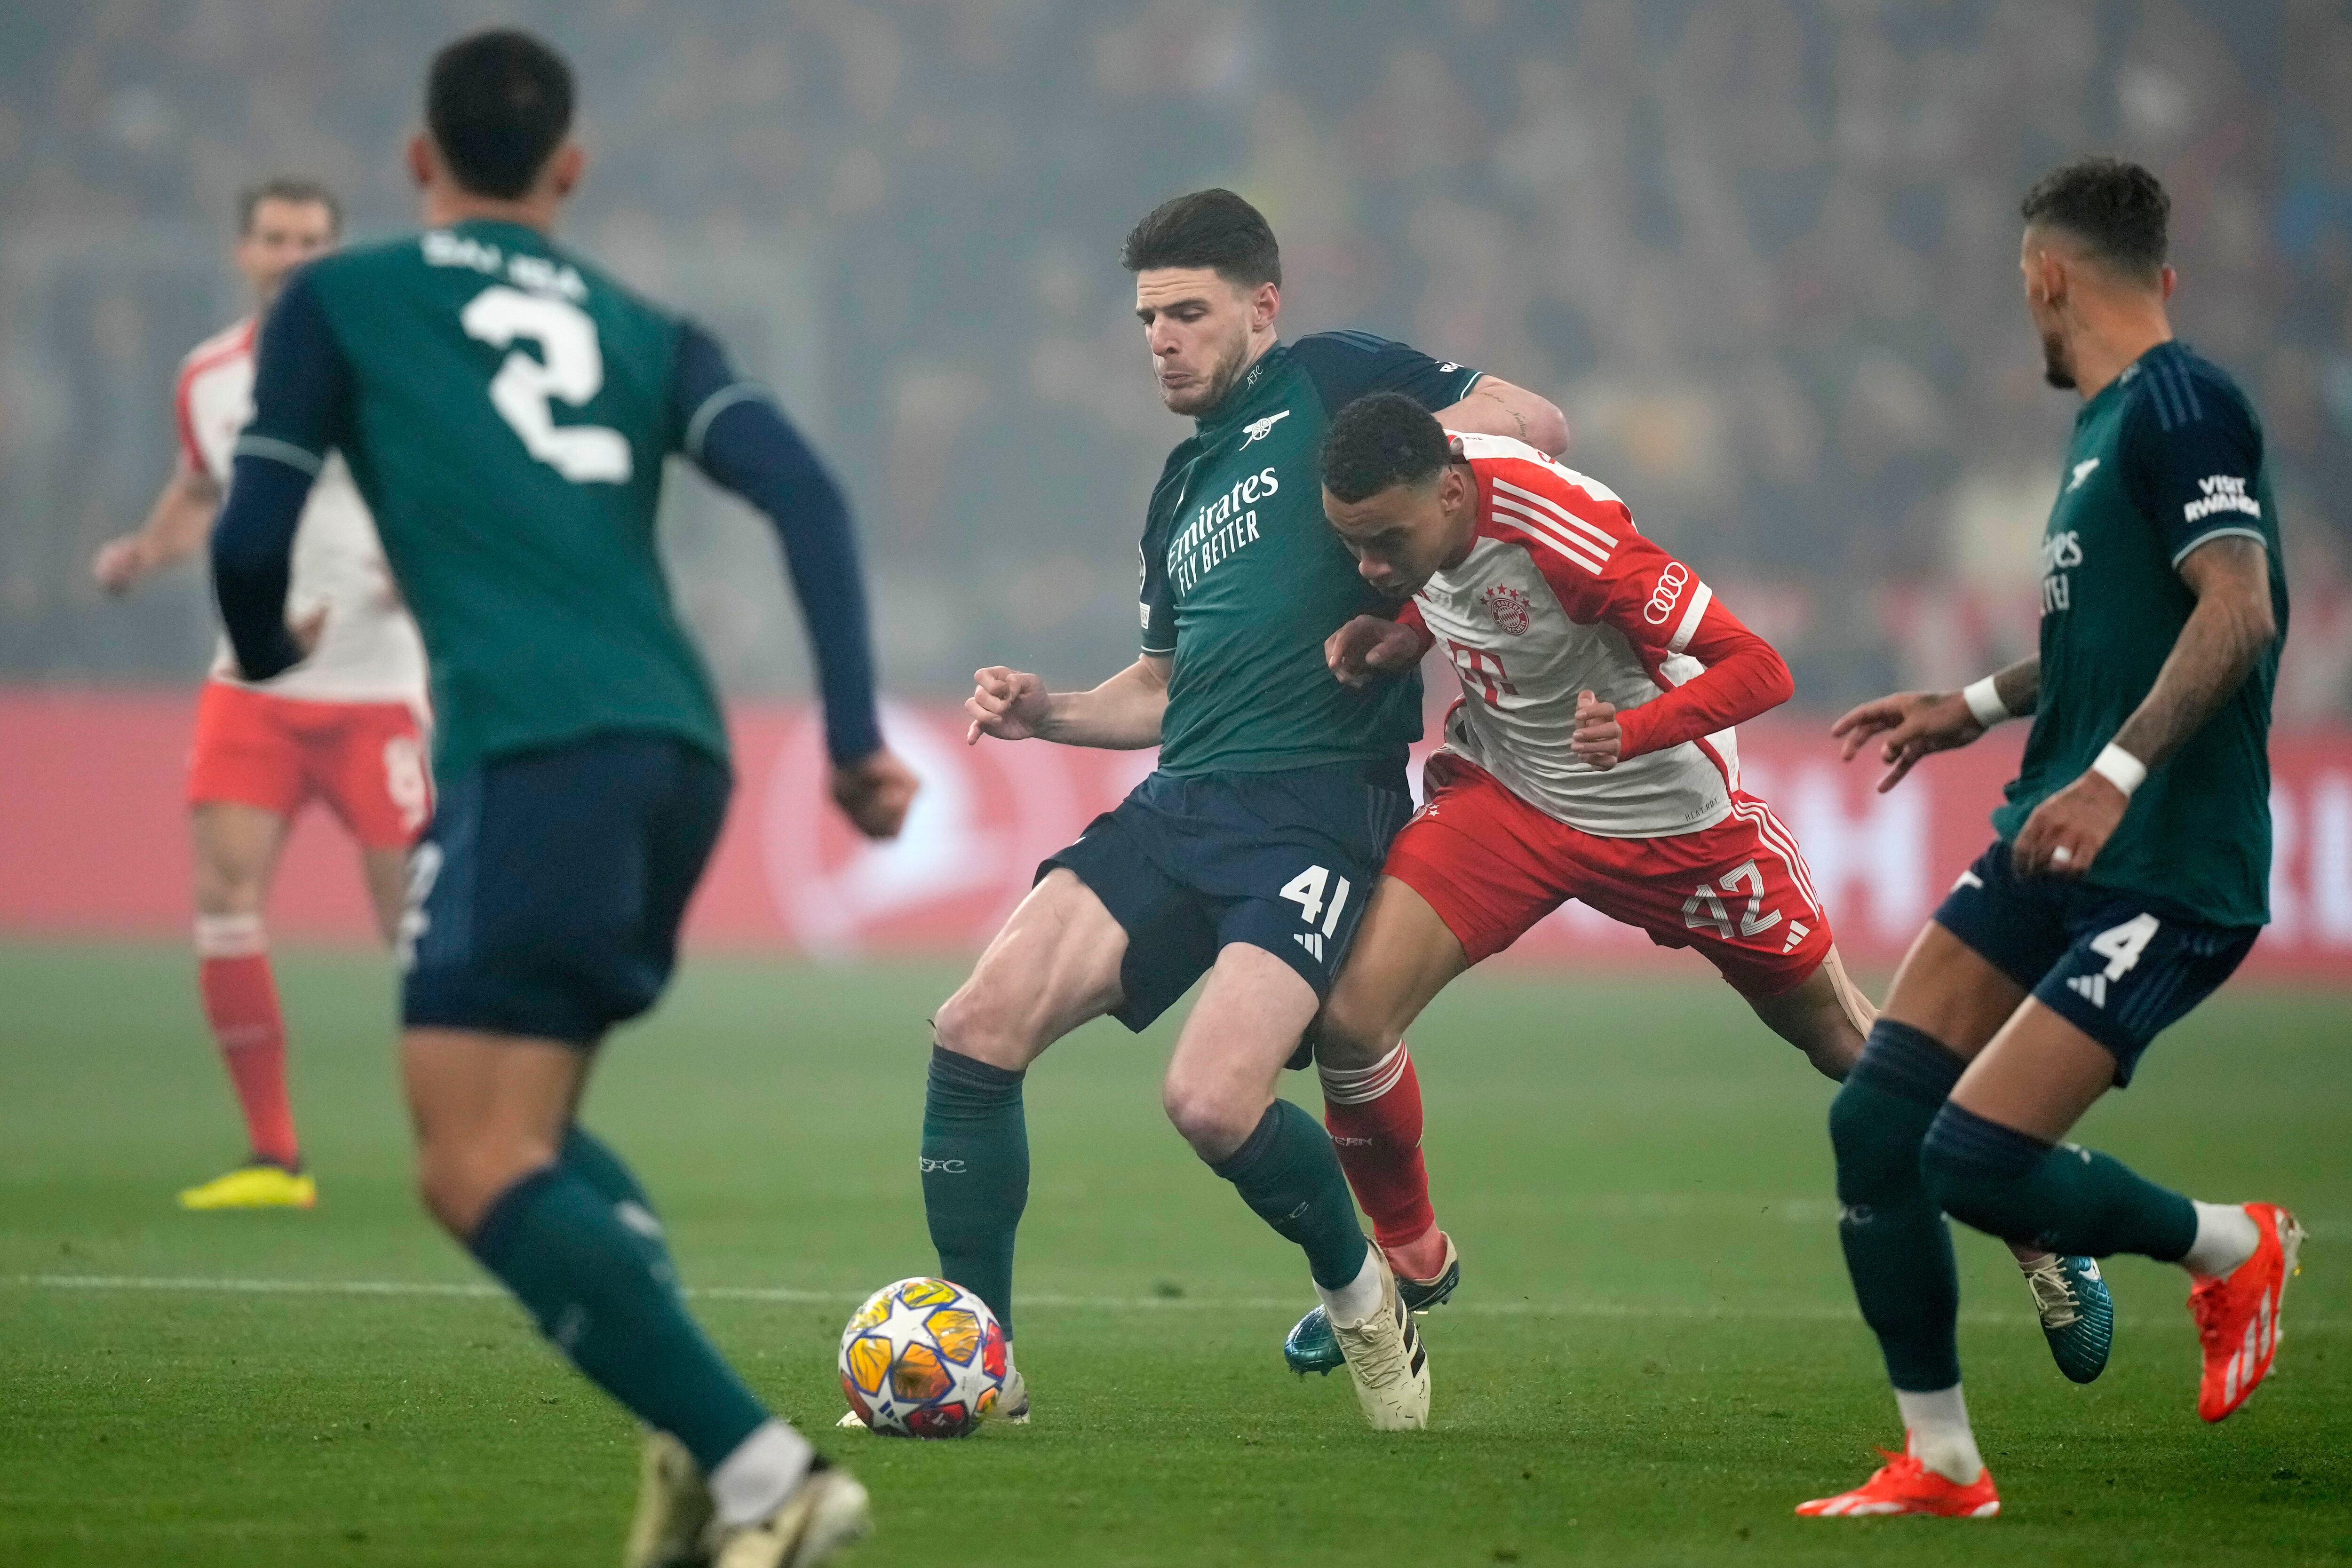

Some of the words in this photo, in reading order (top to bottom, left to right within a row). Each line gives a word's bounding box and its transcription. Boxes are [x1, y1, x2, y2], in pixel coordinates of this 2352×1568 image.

[459, 284, 633, 484] 2
[1168, 467, 1279, 578] Emirates
[1178, 552, 1197, 598] FLY
[1202, 510, 1260, 574] BETTER
[1497, 601, 1523, 614] BAYERN
[1279, 864, 1350, 939] 41
[1681, 858, 1782, 939] 42
[2090, 912, 2161, 982] 4
